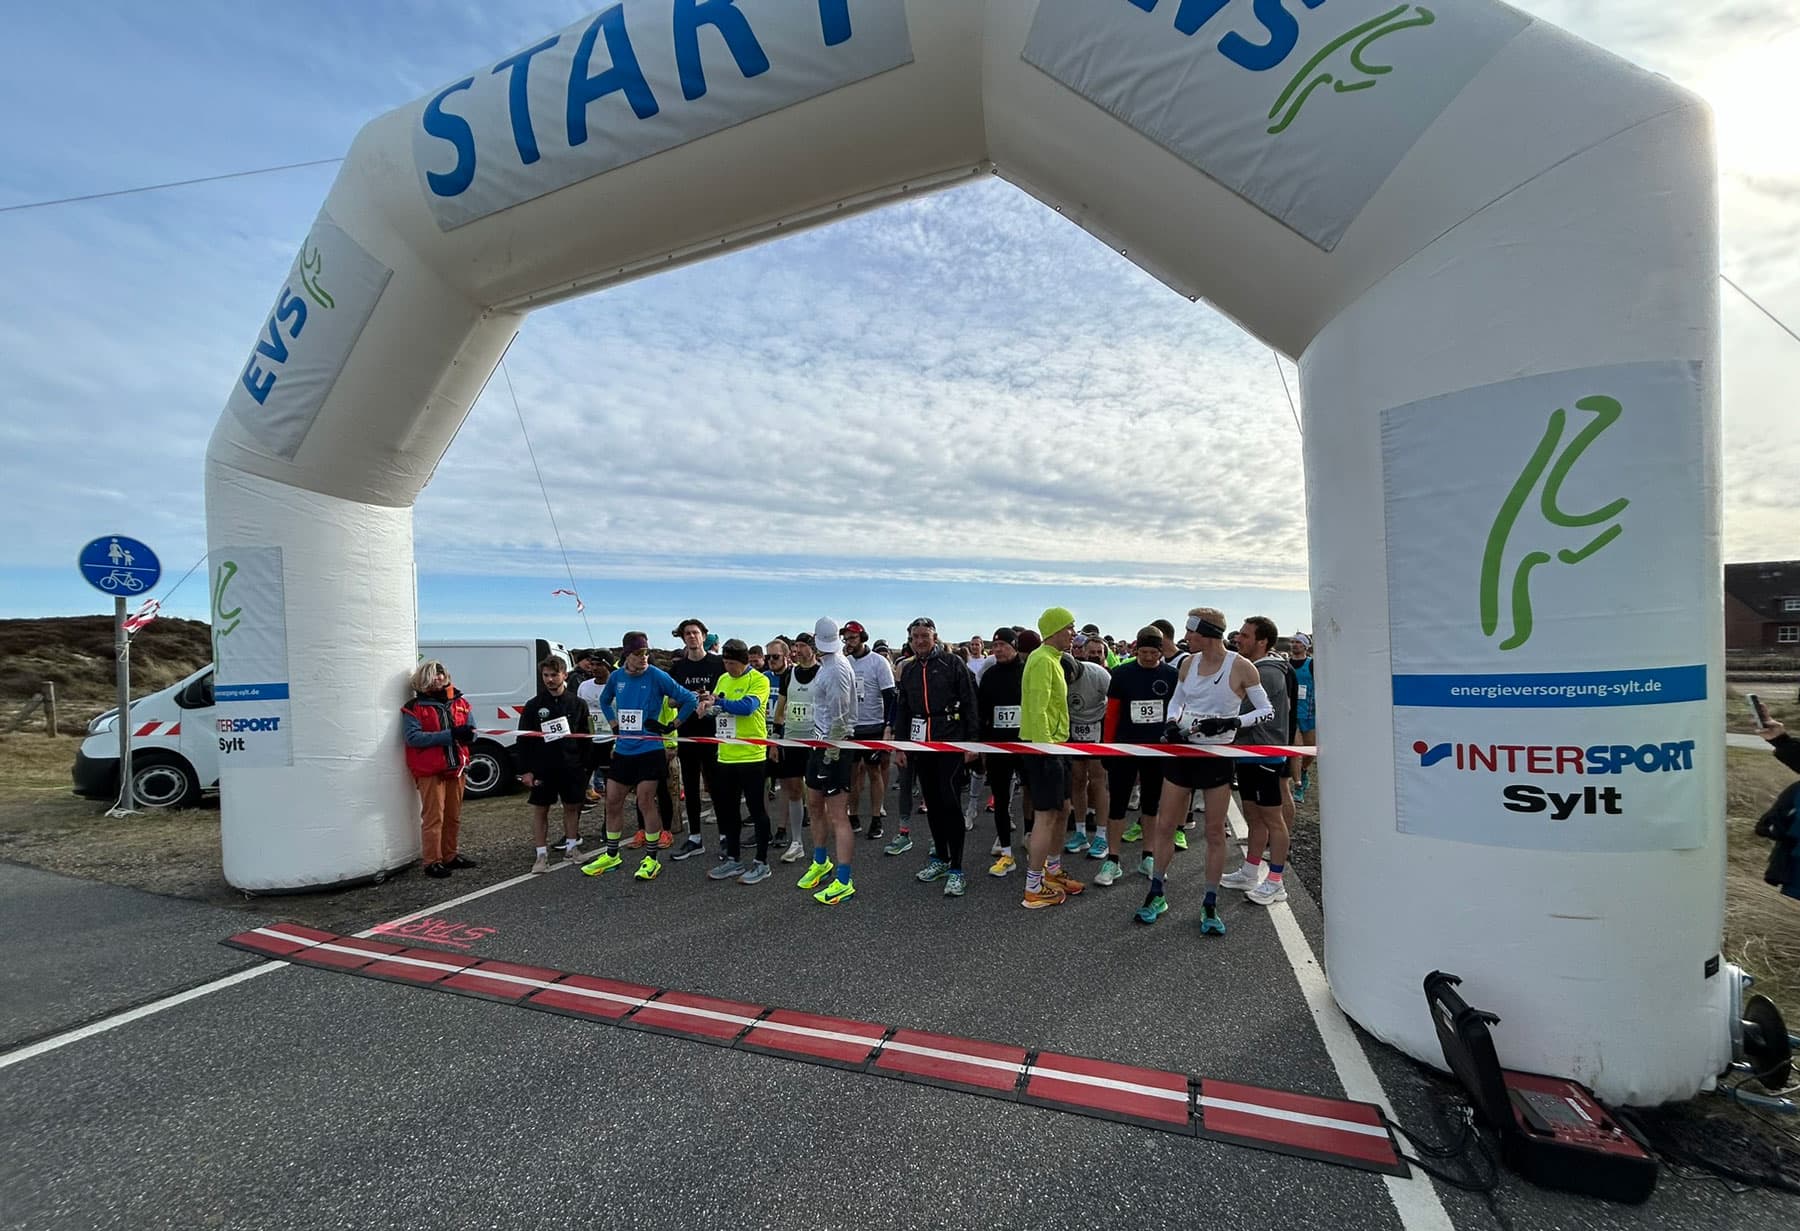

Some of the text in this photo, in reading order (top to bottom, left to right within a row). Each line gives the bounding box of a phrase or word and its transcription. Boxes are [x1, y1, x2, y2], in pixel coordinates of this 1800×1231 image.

[242, 286, 307, 406] EVS
[1450, 679, 1662, 698] energieversorgung-sylt.de
[792, 706, 806, 715] 411
[998, 711, 1015, 721] 617
[1140, 706, 1154, 716] 93
[621, 714, 636, 724] 848
[550, 723, 562, 733] 58
[219, 737, 246, 754] Sylt
[1456, 740, 1695, 775] INTERSPORT
[1503, 784, 1622, 820] Sylt
